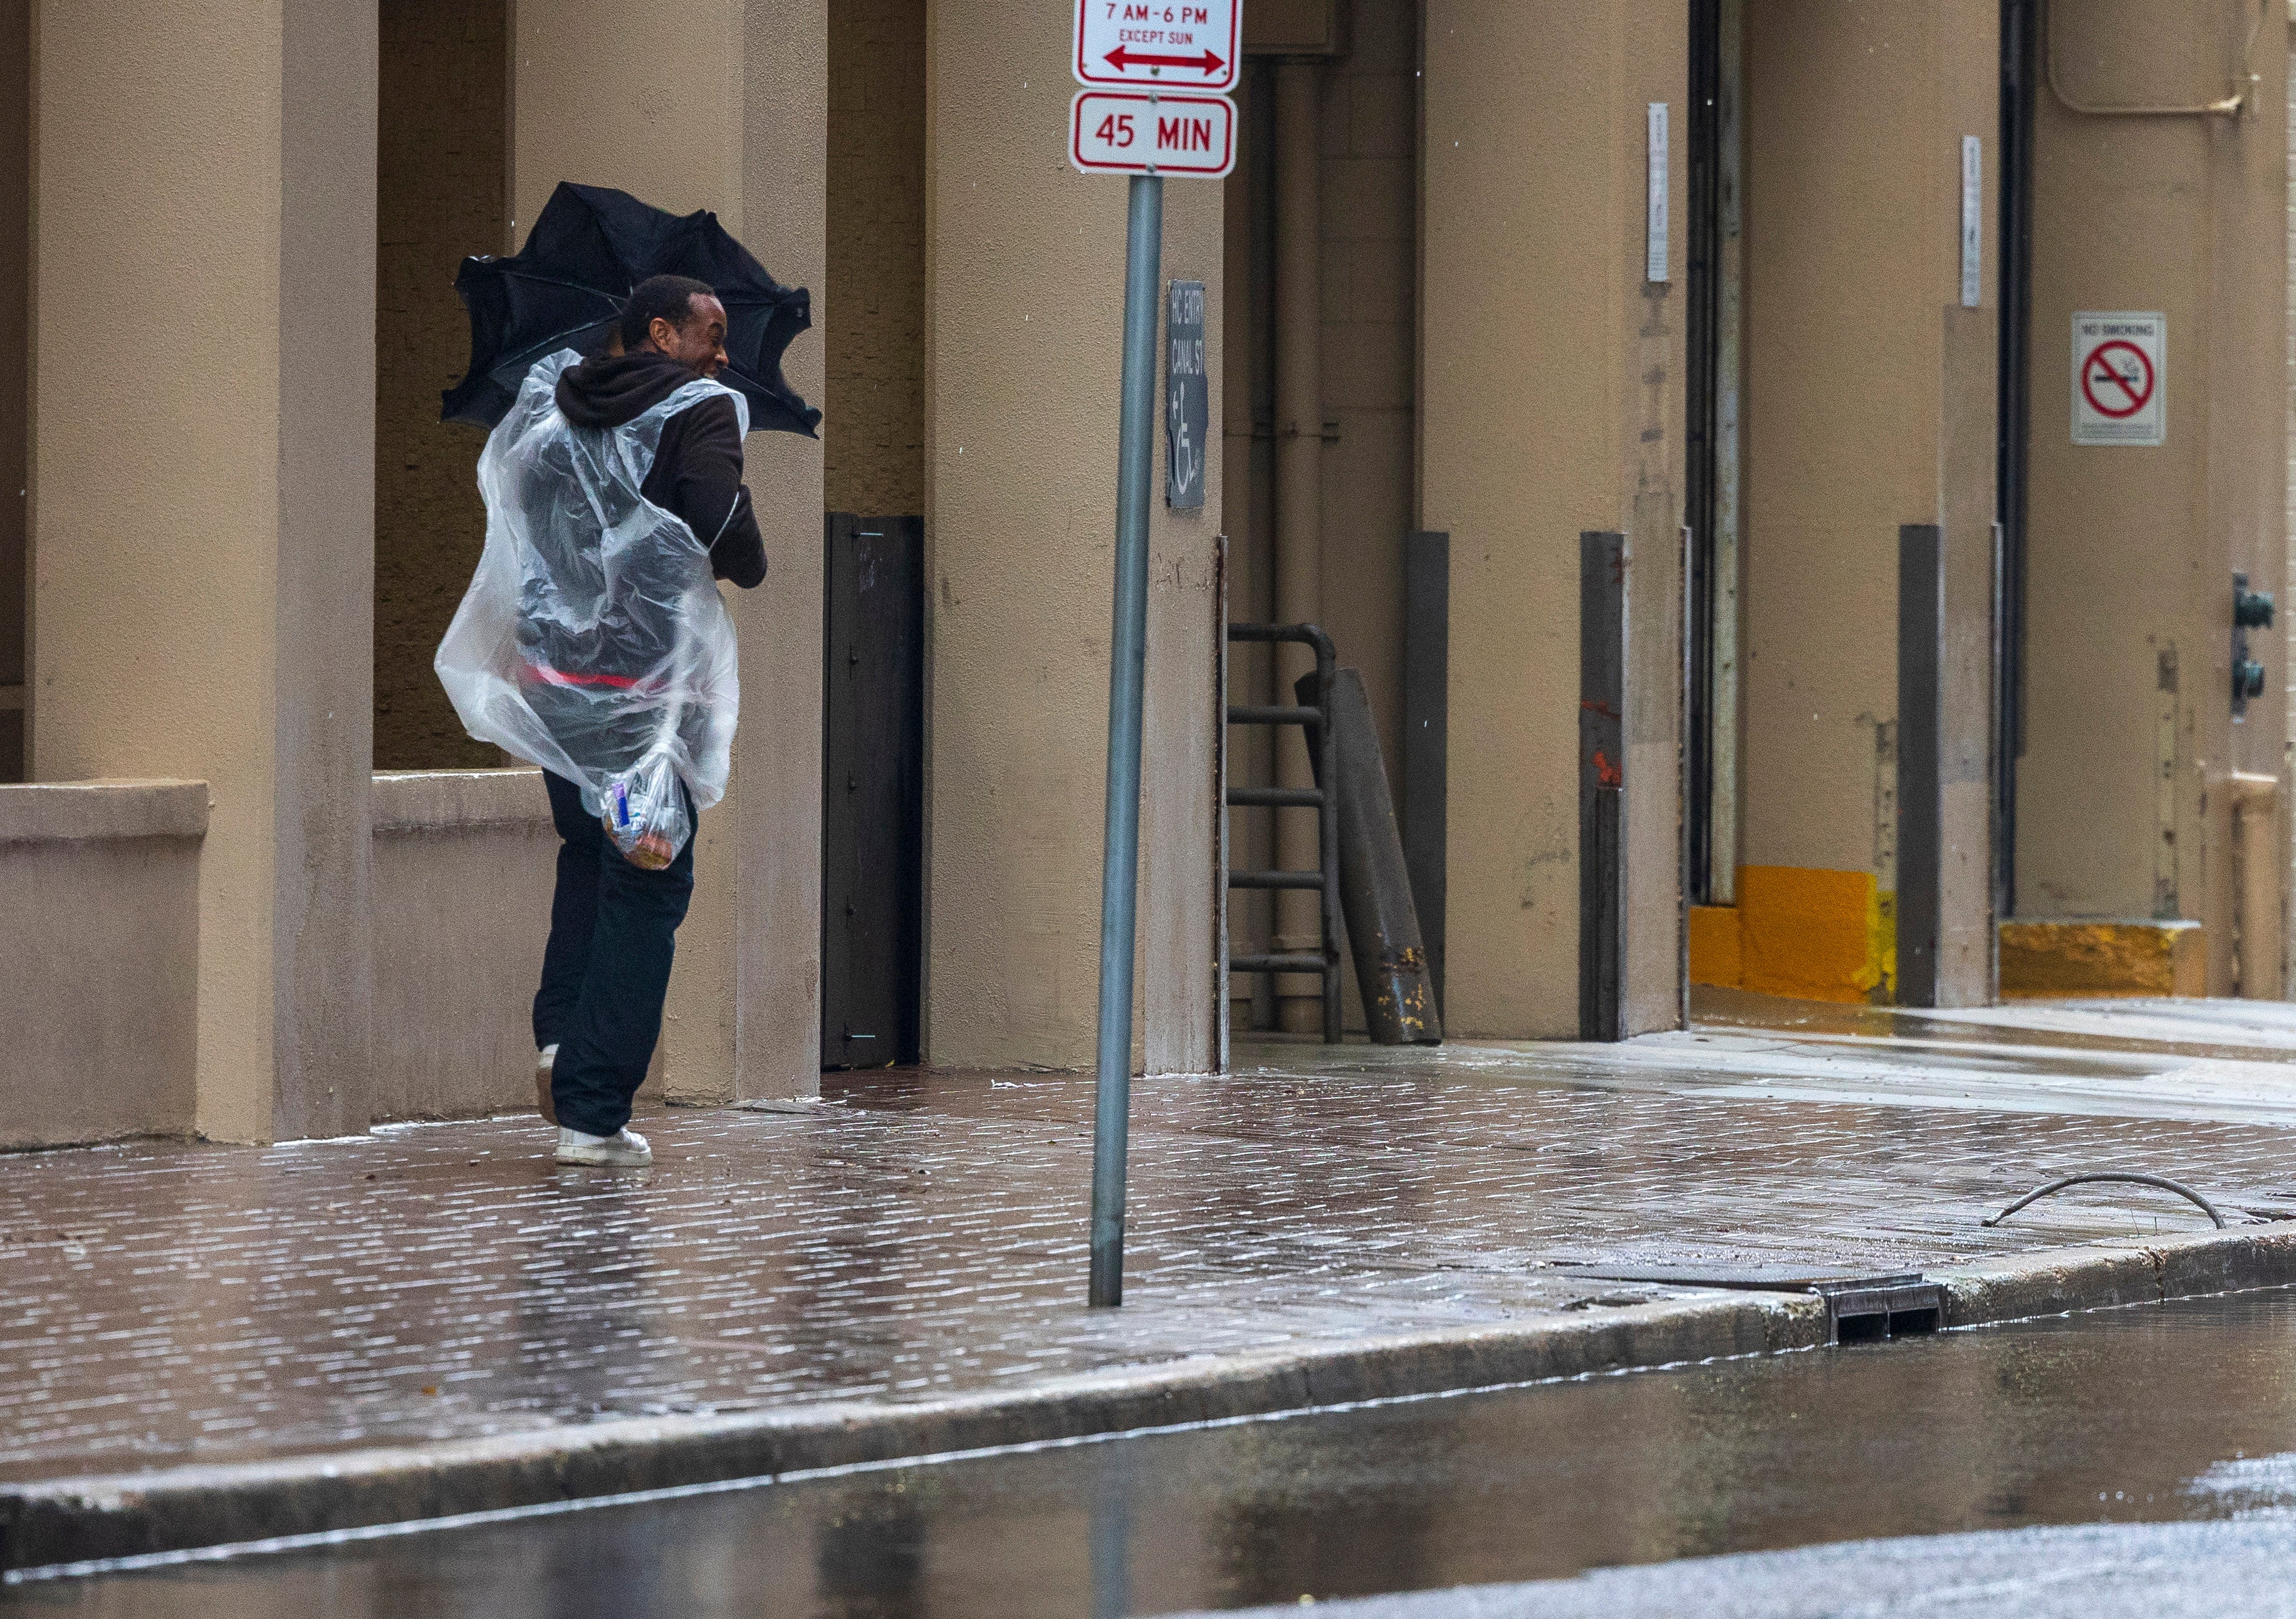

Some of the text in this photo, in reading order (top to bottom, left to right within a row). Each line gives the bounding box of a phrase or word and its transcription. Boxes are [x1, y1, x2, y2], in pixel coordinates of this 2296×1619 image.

[1107, 3, 1116, 19] 7
[1182, 7, 1208, 24] PM
[1119, 29, 1193, 44] EXCEPT SUN
[1095, 114, 1211, 152] 45 MIN
[1172, 338, 1203, 375] CANAL ST
